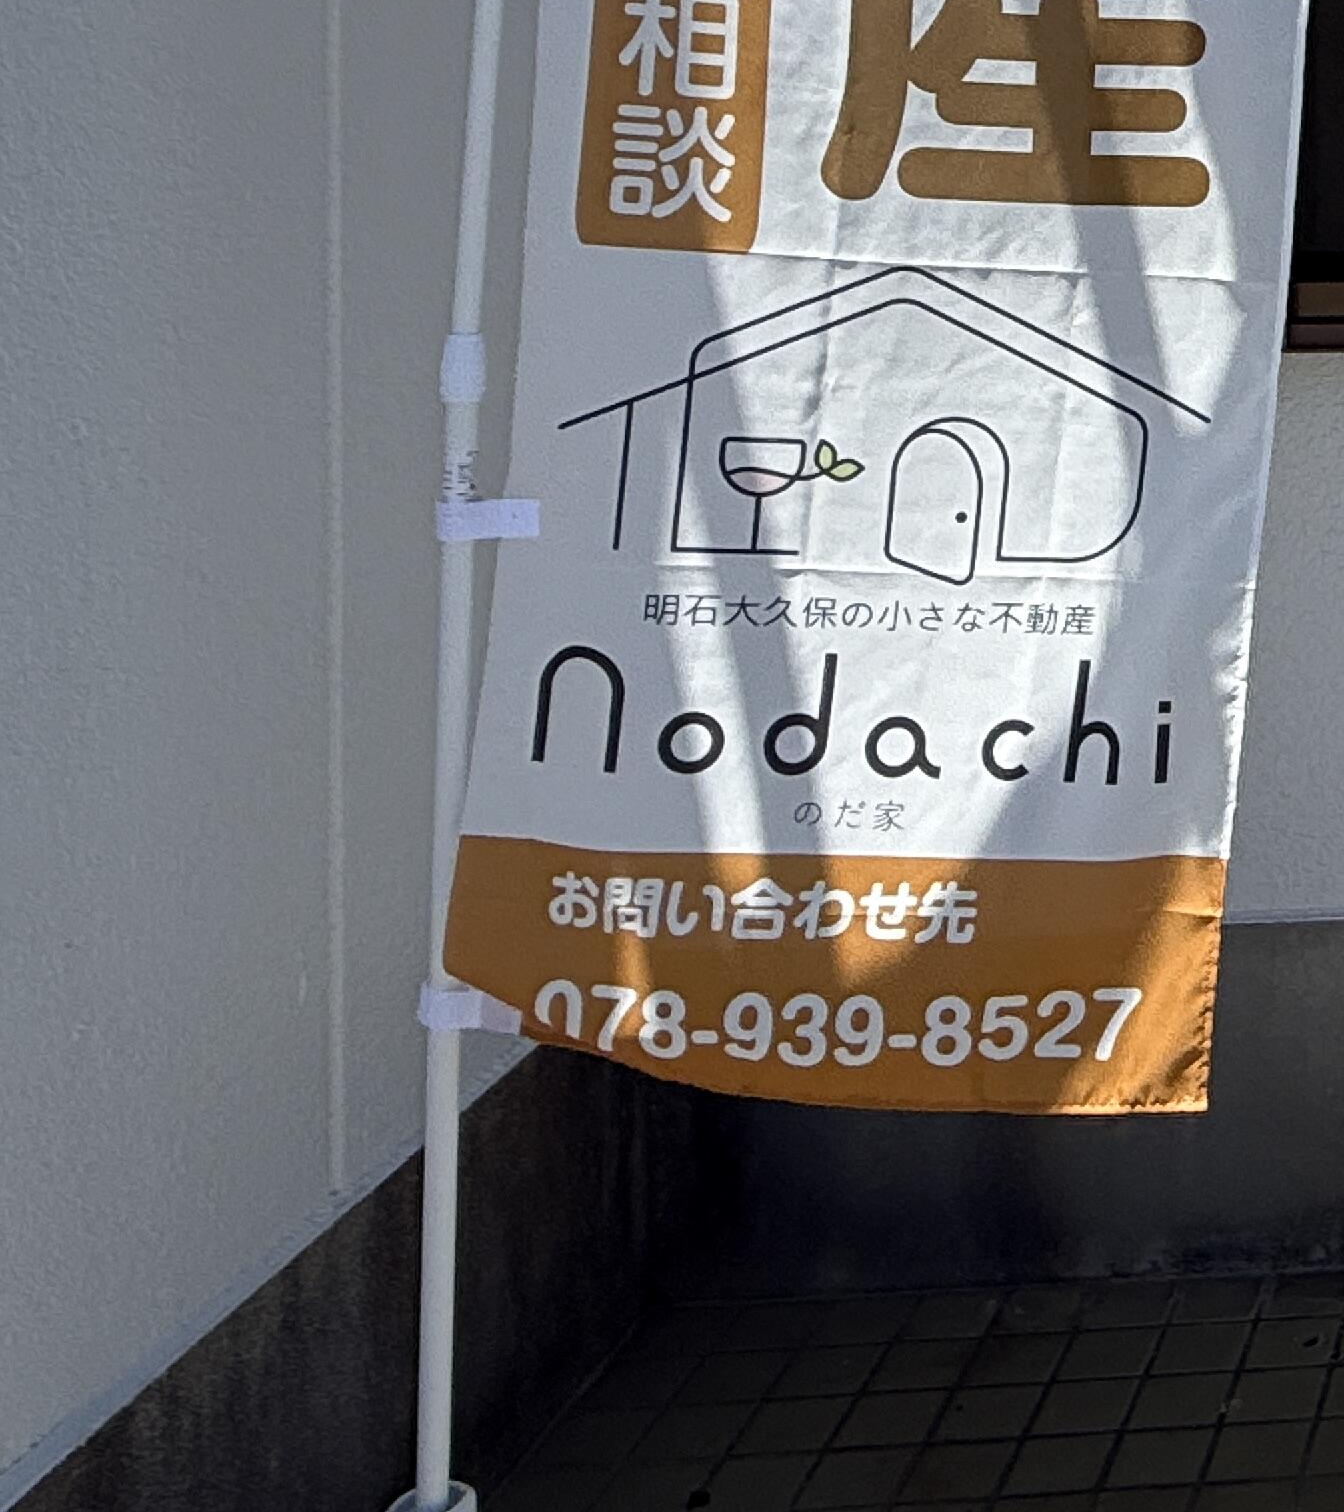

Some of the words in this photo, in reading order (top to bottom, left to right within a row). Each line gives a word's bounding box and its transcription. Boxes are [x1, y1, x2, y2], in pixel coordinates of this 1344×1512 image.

[642, 592, 1097, 638] 明石大久保の小さな不動産
[530, 643, 1173, 786] nodachi
[793, 799, 907, 832] のだ家
[548, 870, 978, 946] お問い合わせ先
[534, 978, 1143, 1068] 078-939-8527
